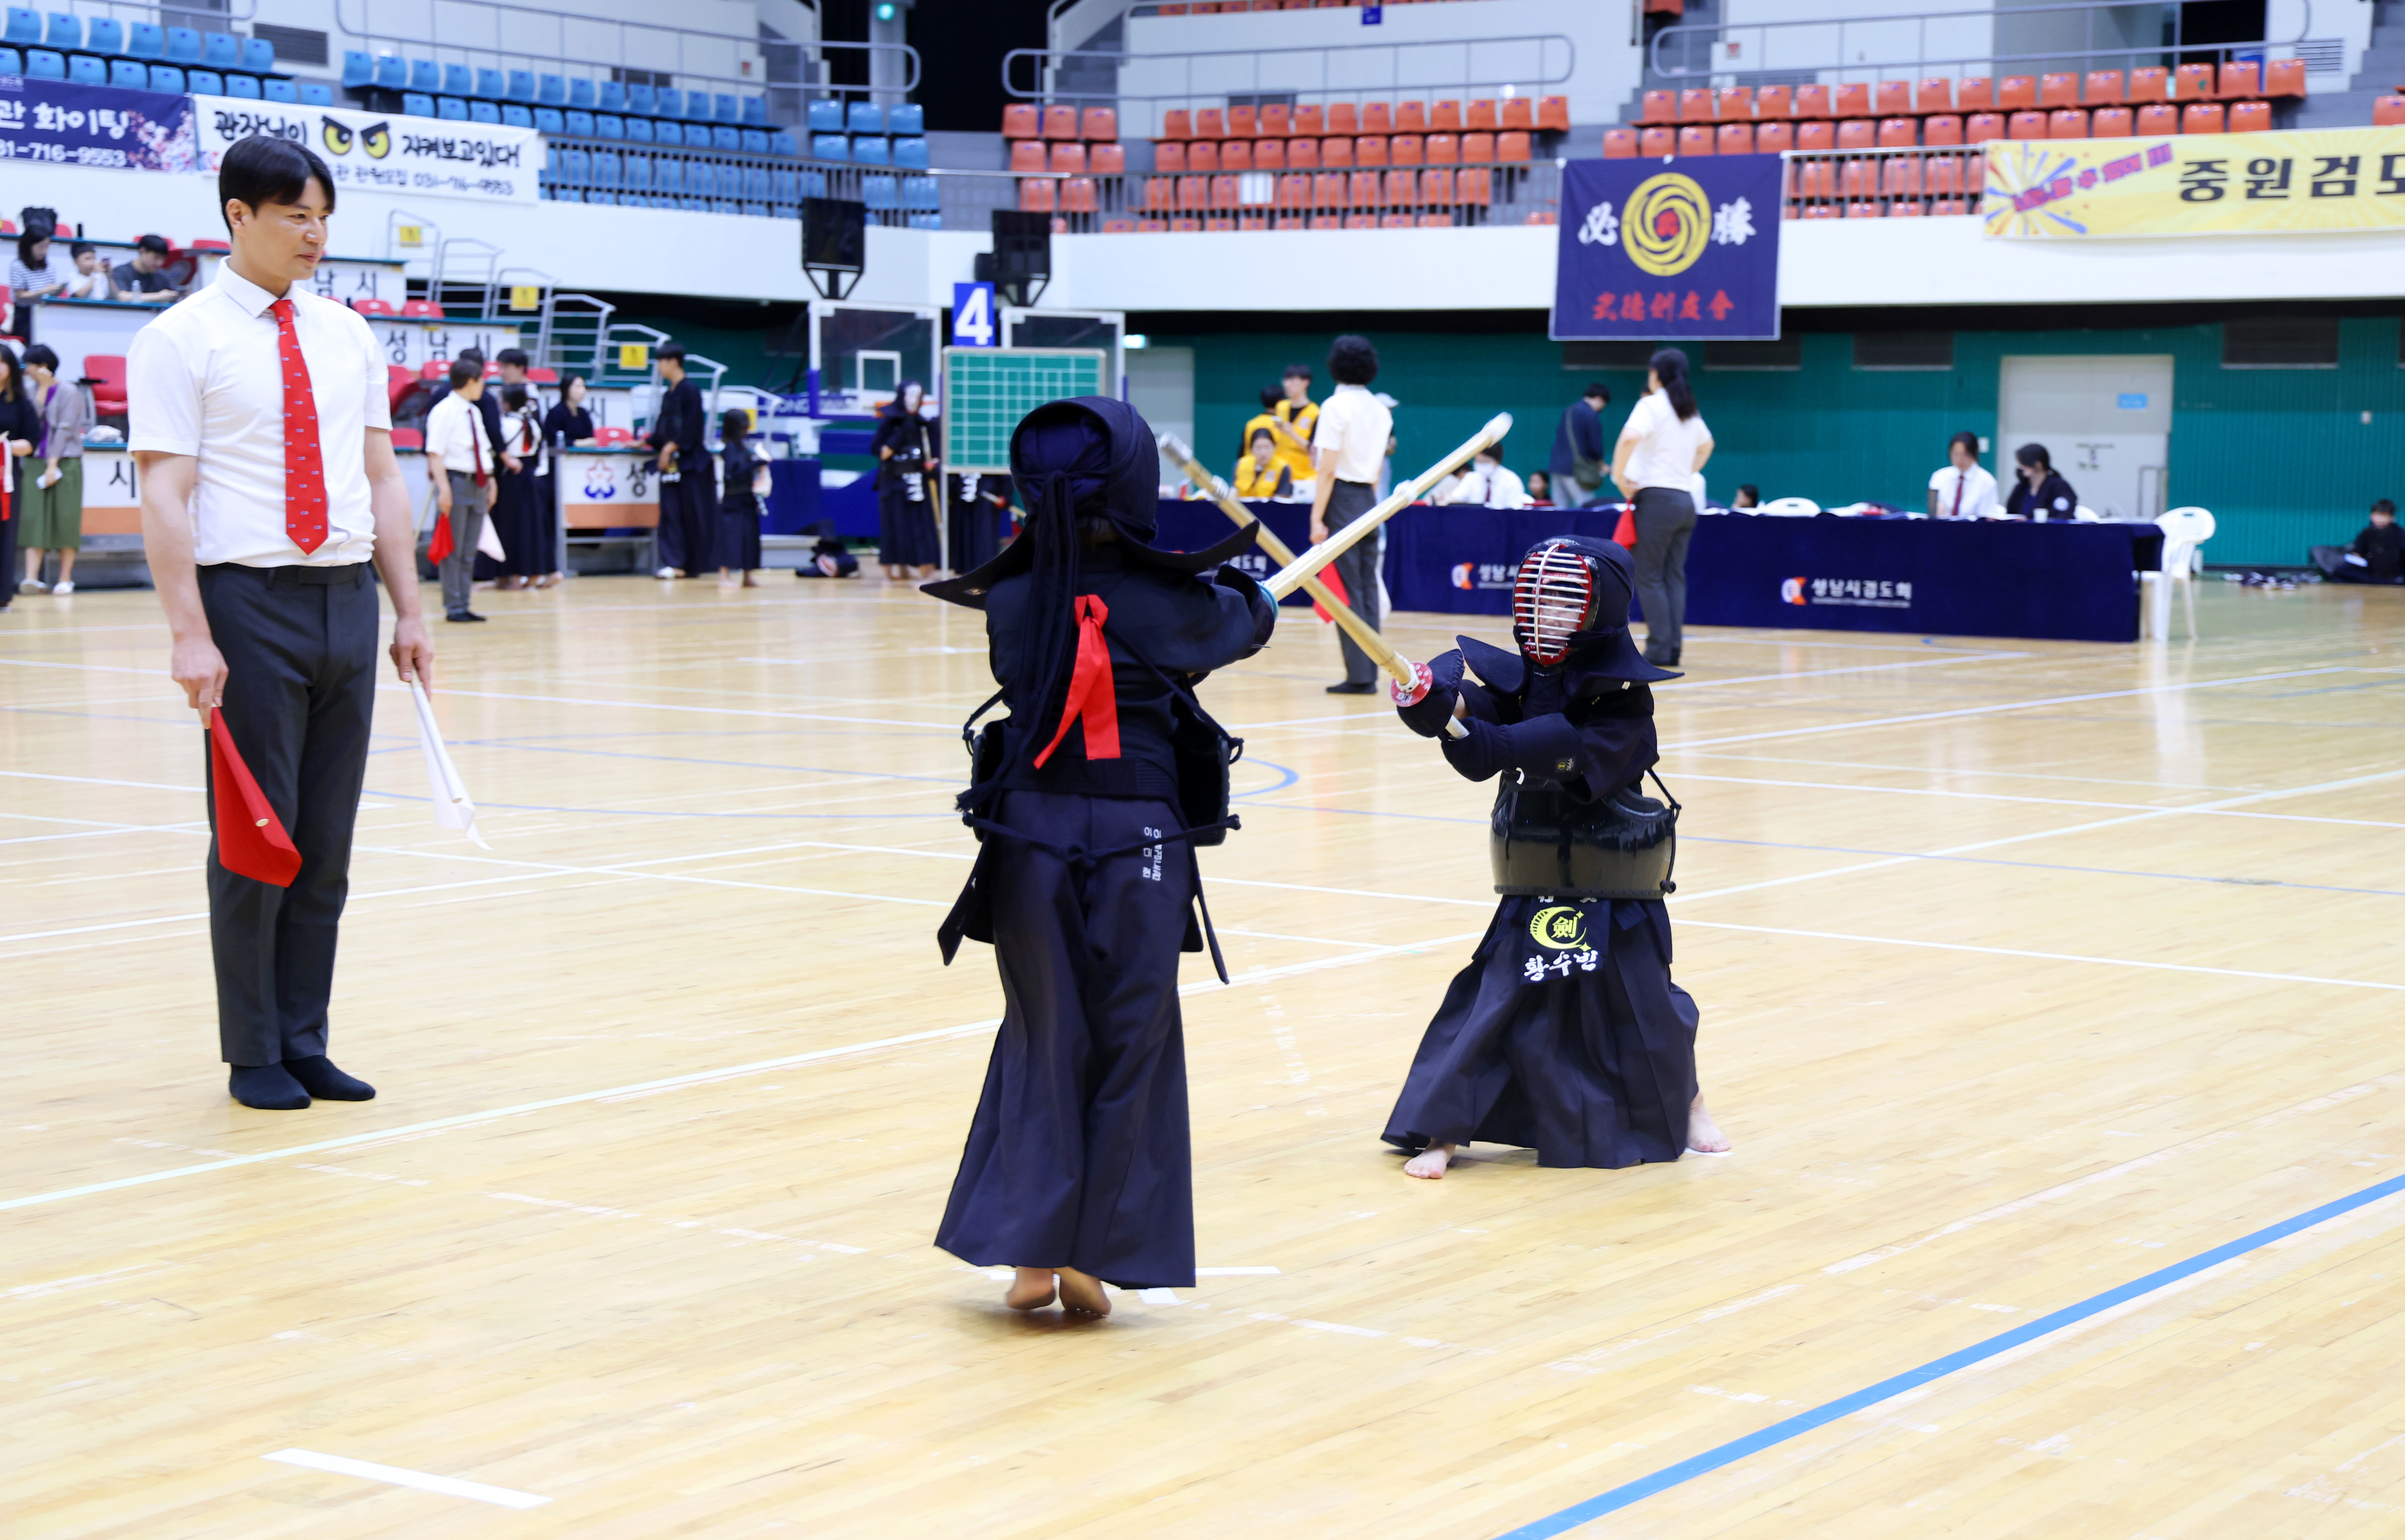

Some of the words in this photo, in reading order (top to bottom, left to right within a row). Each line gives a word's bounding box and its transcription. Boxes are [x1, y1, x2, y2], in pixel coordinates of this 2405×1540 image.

[33, 101, 129, 140] 화이팅
[1578, 201, 1619, 246] 必
[1711, 196, 1757, 246] 勝
[954, 288, 993, 345] 4
[1811, 578, 1912, 600] 성남시검도회
[1523, 950, 1598, 981] 황수빈
